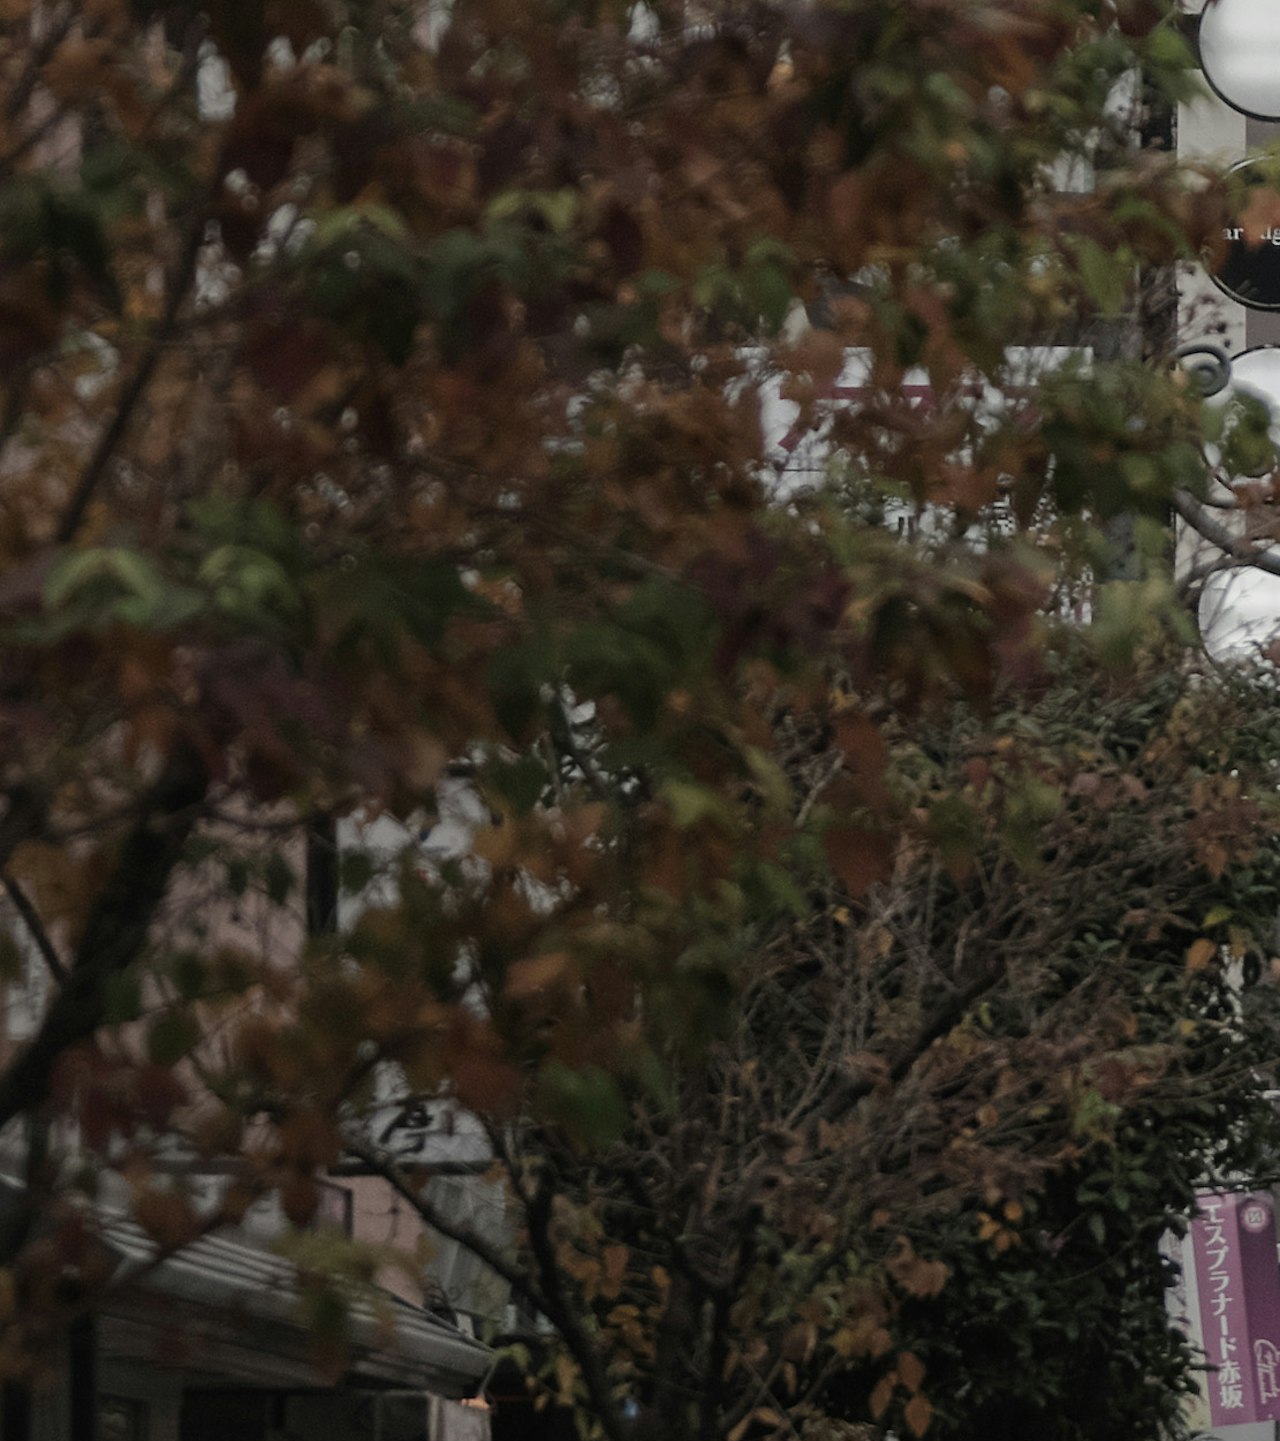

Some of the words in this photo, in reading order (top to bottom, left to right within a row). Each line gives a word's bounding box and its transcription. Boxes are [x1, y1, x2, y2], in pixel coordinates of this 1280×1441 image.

[1201, 1204, 1244, 1409] エスプラナード赤坂
